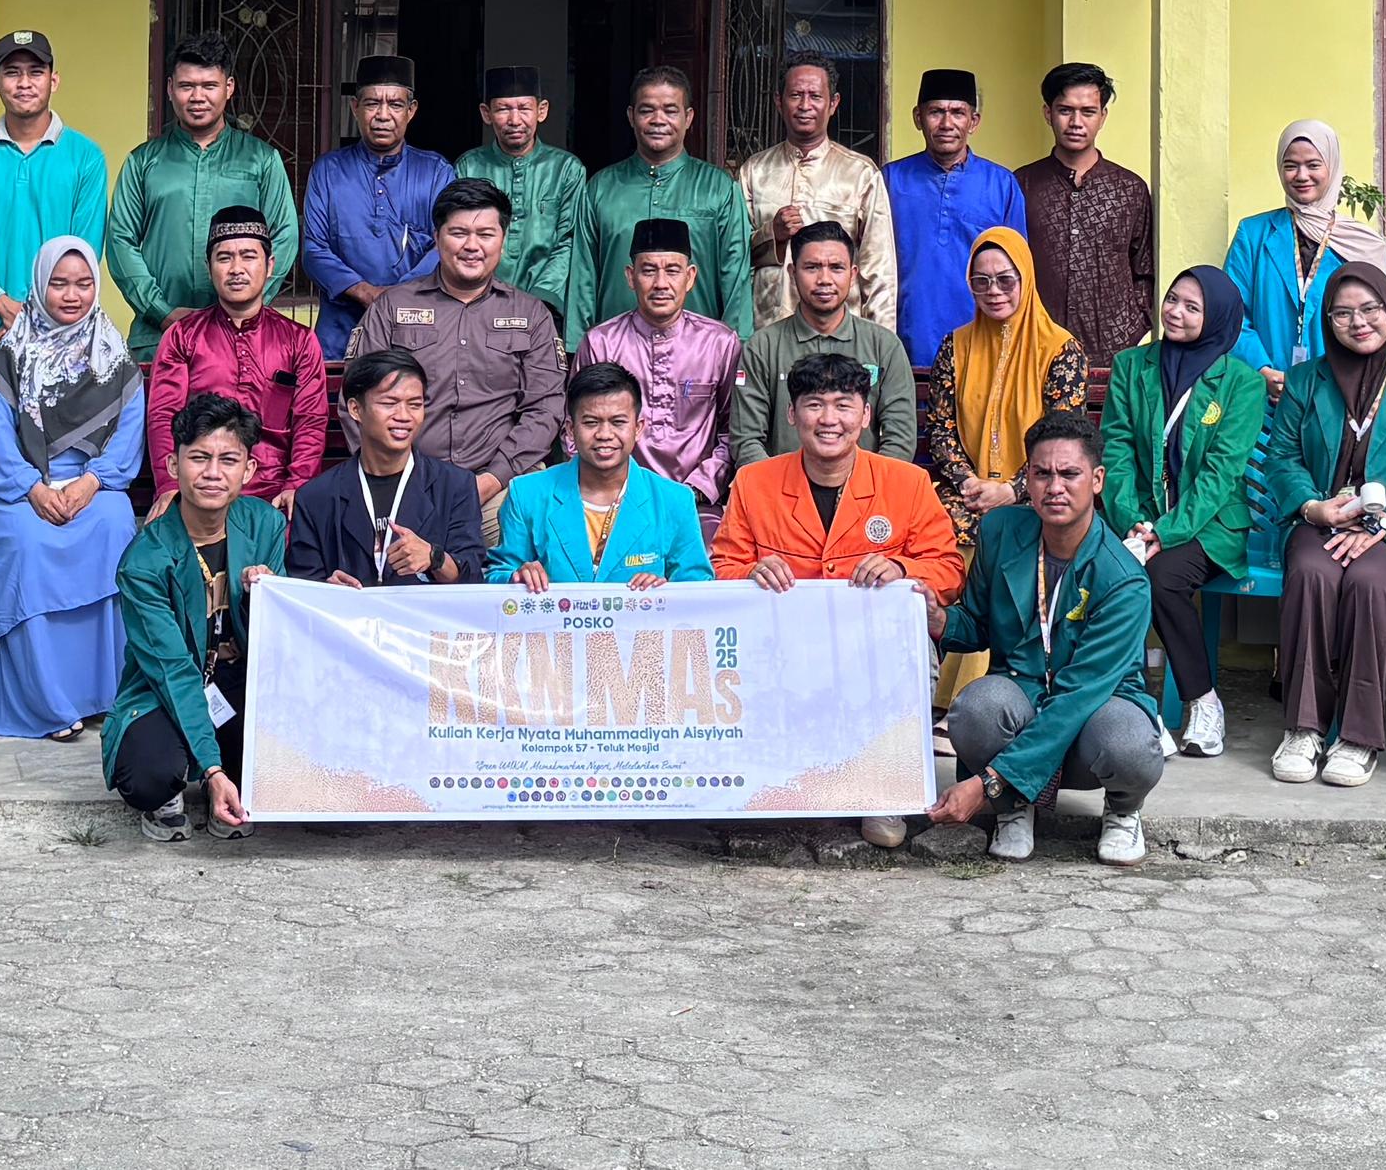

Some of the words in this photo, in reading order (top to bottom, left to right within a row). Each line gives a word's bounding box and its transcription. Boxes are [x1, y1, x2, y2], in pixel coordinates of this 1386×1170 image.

[563, 617, 614, 629] POSKO
[714, 627, 738, 648] 20
[716, 648, 738, 668] 25
[428, 630, 574, 726] KKN
[428, 726, 472, 739] Kuliah
[476, 727, 515, 741] Kerja
[518, 728, 561, 743] Nyata
[564, 727, 679, 743] Muhammadiyah
[683, 726, 743, 743] Aisyiyah
[521, 743, 573, 754] Kelompok
[576, 743, 588, 752] 57
[598, 743, 624, 752] Teluk
[627, 743, 660, 754] Mesjid
